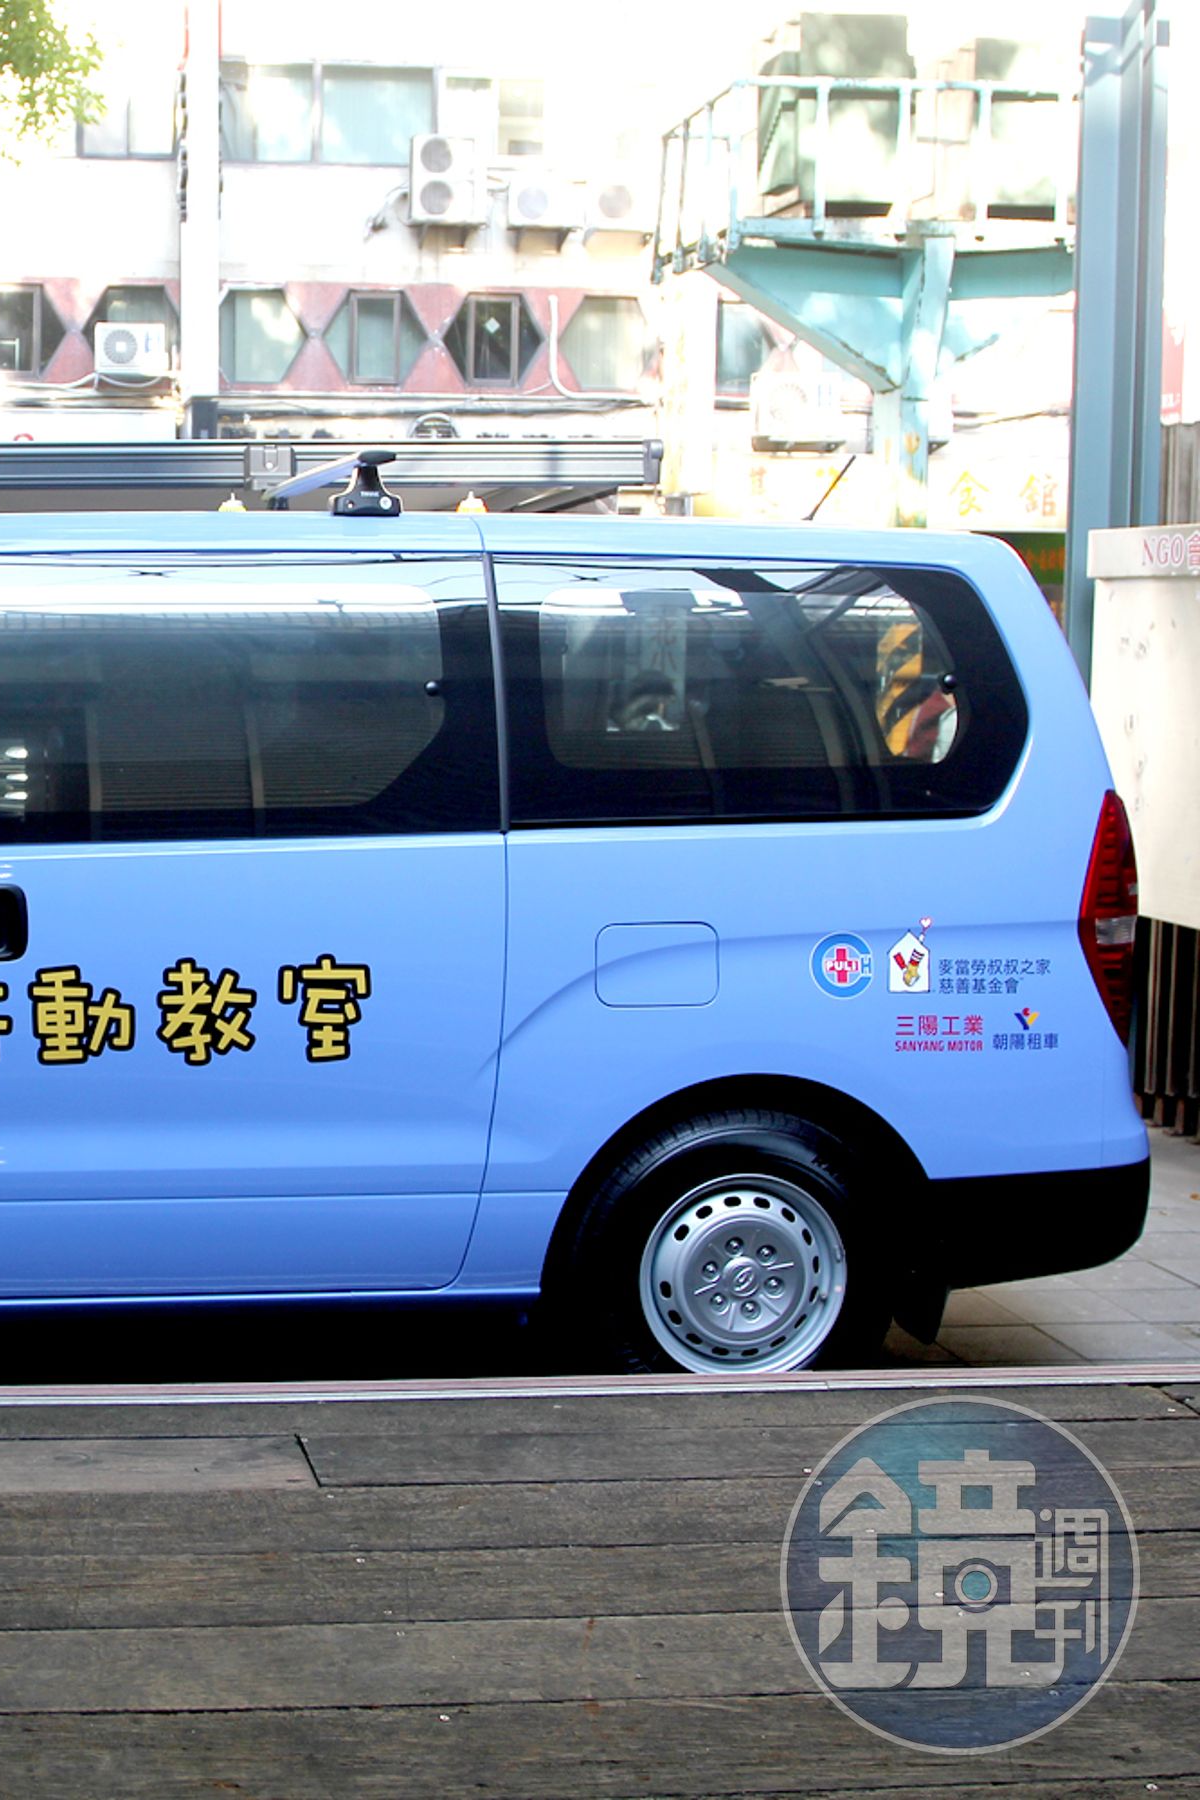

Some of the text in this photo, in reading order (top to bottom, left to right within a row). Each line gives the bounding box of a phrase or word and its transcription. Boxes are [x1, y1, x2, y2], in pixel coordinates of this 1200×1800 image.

[826, 959, 858, 972] PULI
[939, 959, 1051, 976] 麥當勞叔叔之家
[939, 977, 1020, 994] 慈善基金會
[895, 1015, 984, 1036] 三陽工業
[895, 1040, 983, 1052] SANYANG MOTOR
[992, 1033, 1059, 1050] 朝陽租車
